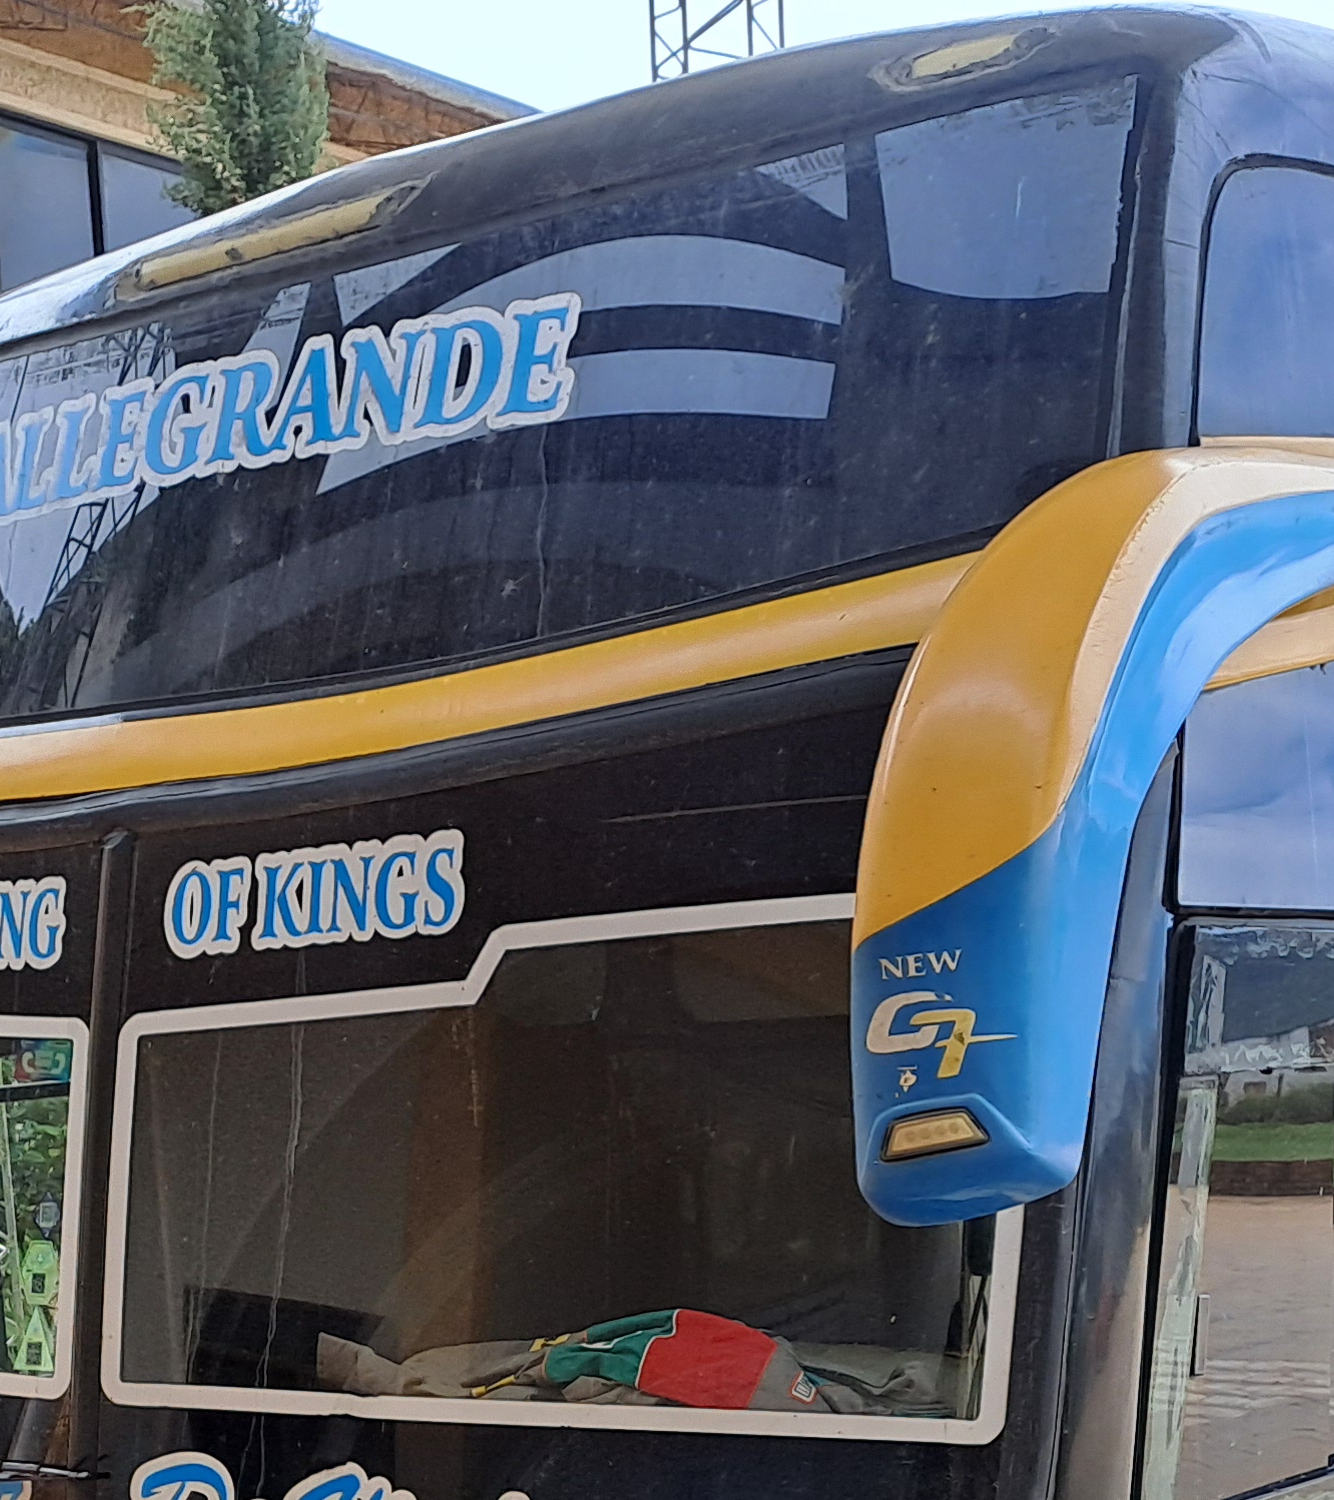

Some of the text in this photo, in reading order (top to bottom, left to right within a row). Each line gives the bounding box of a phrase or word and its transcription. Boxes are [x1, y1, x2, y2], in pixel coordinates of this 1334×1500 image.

[166, 829, 464, 959] OF KINGS
[878, 949, 962, 981] NEW
